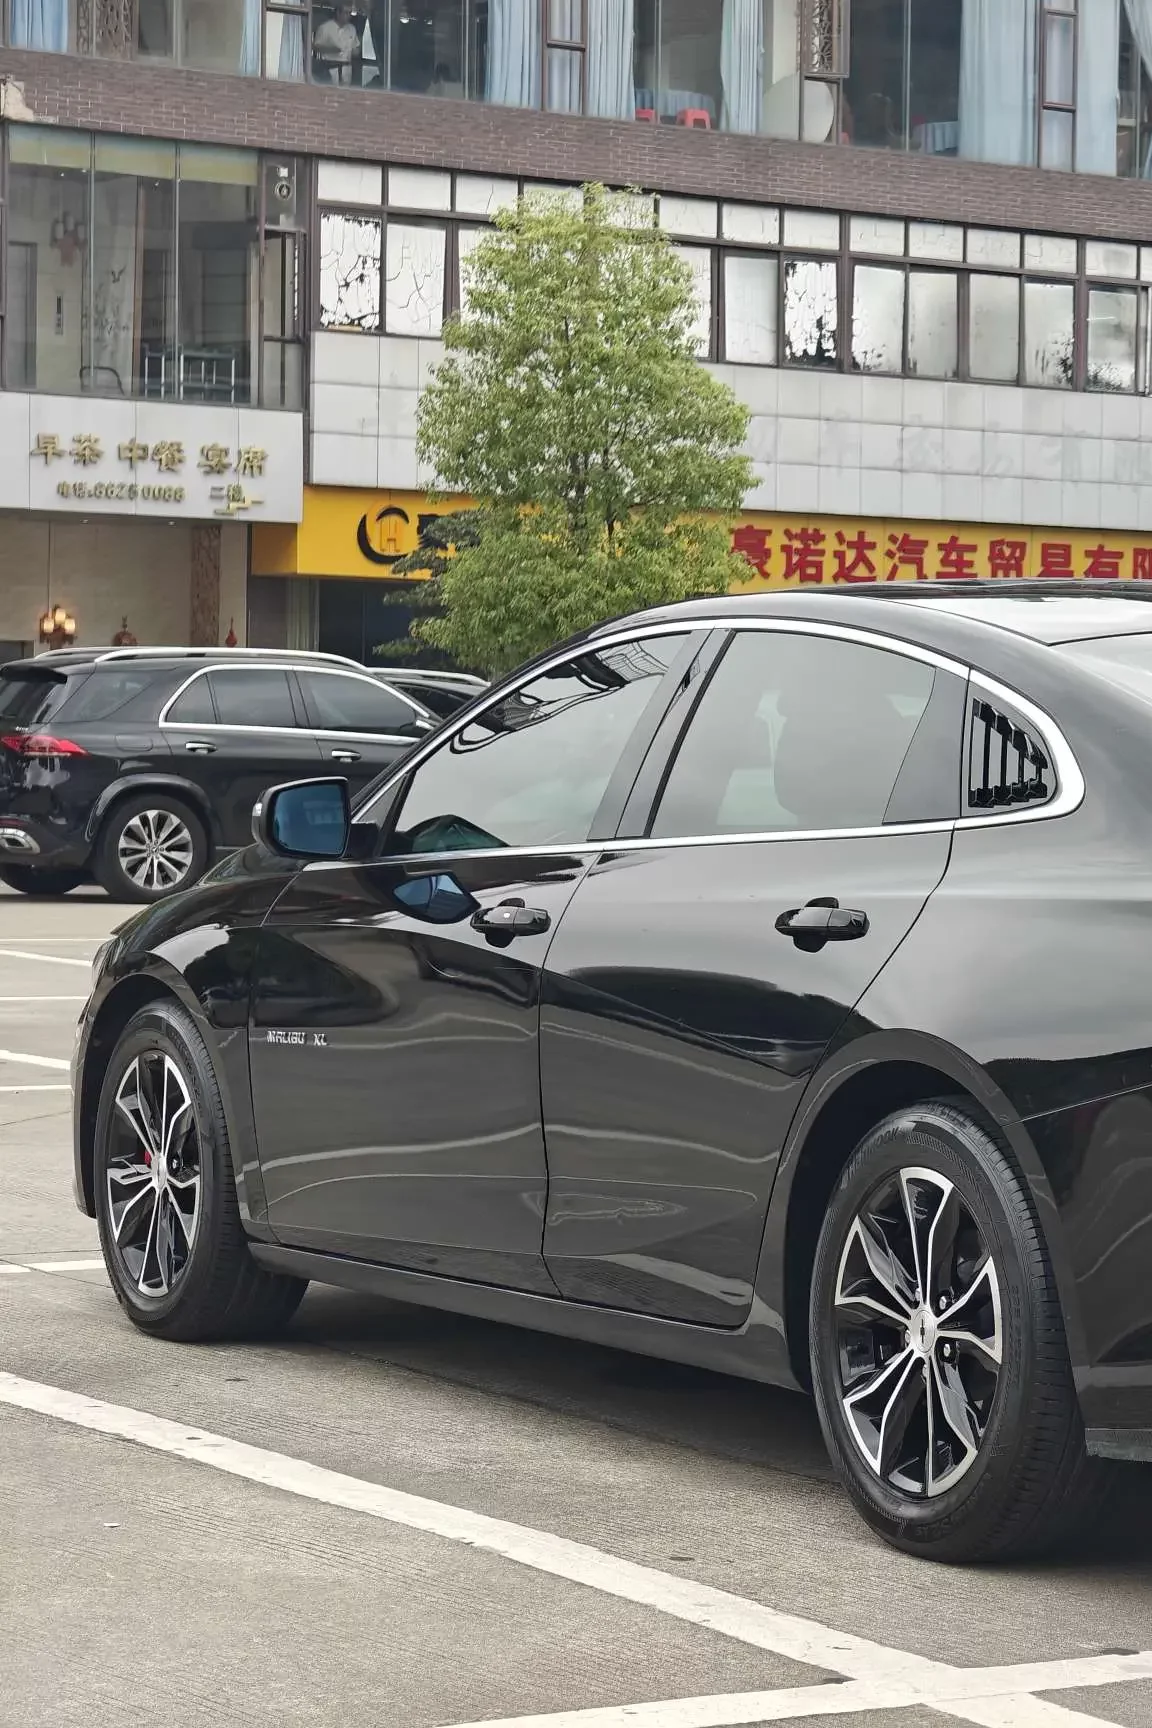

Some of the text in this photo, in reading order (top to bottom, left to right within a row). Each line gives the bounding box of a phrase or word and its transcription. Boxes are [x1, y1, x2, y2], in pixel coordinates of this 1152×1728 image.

[30, 433, 104, 466] 早茶
[117, 437, 186, 473] 中餐
[266, 1030, 328, 1046] MALIBU XL
